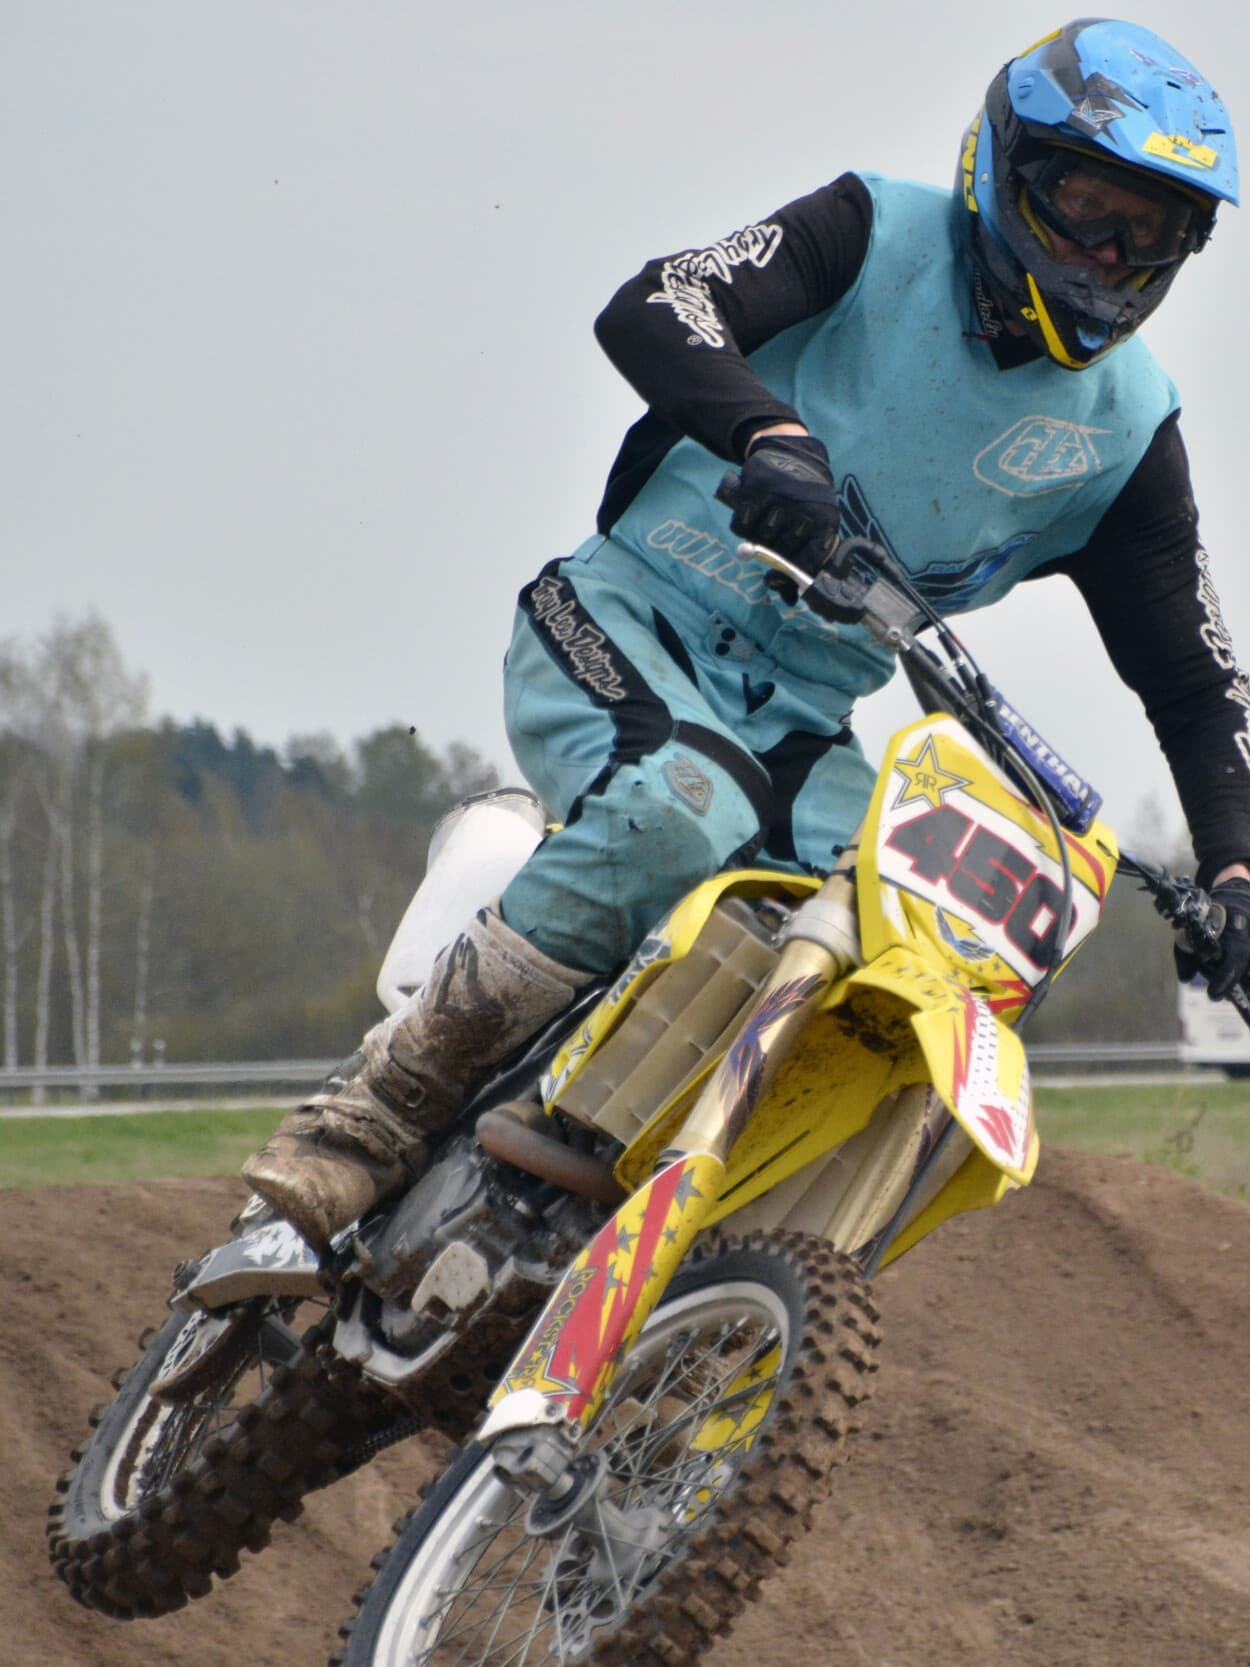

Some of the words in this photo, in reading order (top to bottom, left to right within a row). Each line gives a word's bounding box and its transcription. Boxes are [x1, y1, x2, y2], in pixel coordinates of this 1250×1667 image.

[531, 576, 564, 620] Troy
[545, 600, 576, 641] Lee
[562, 623, 626, 700] Designs
[885, 803, 1078, 972] 450
